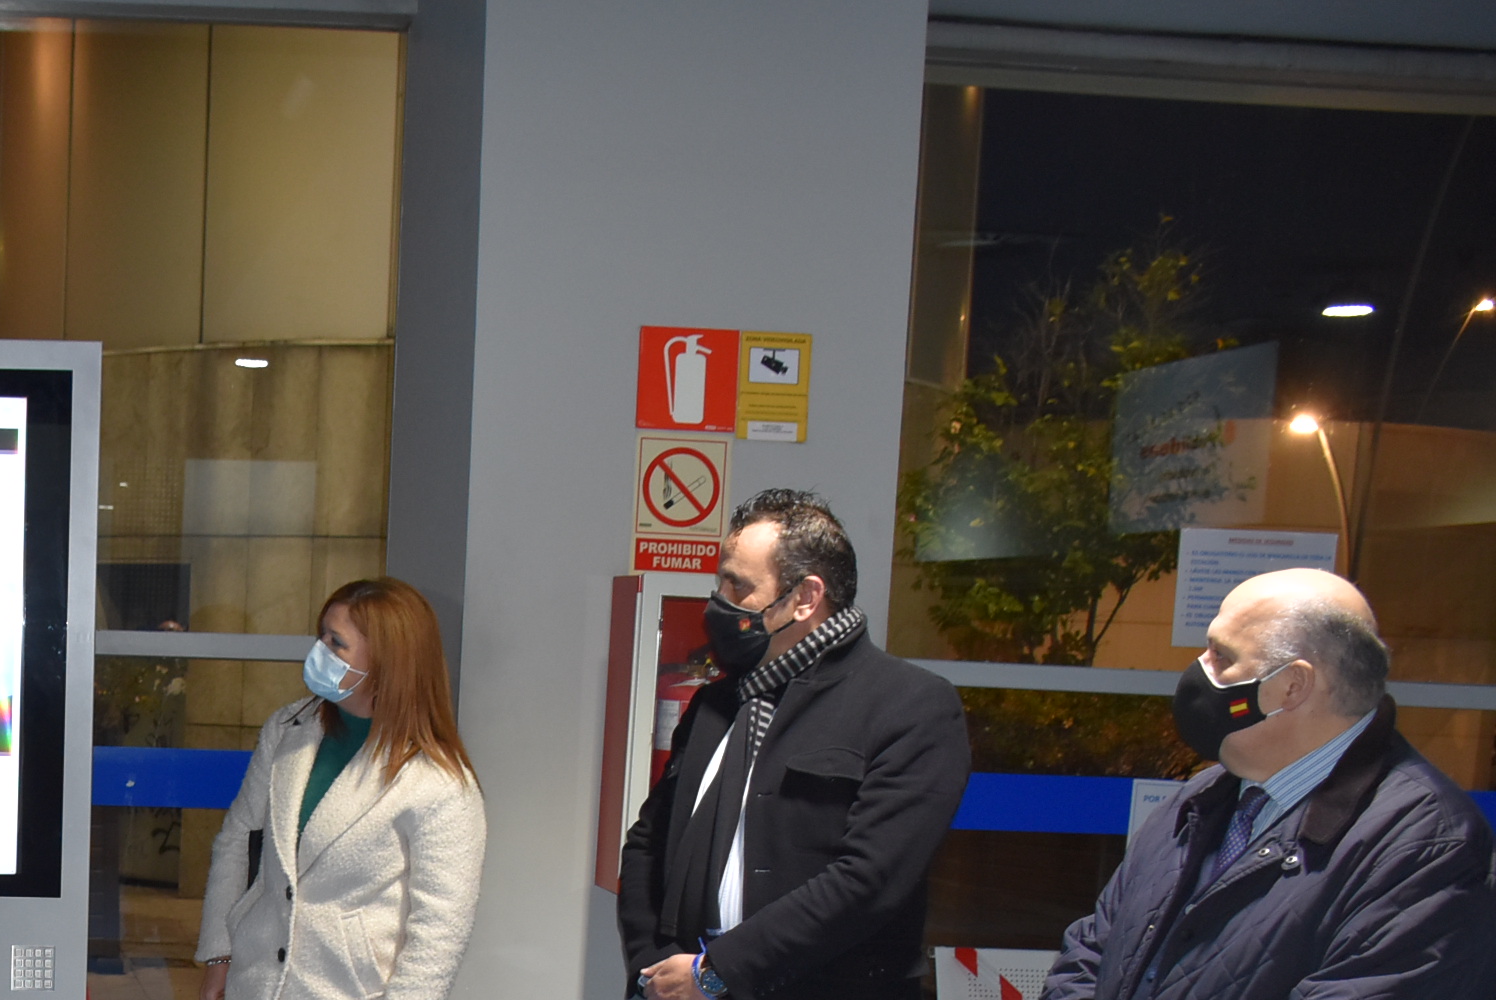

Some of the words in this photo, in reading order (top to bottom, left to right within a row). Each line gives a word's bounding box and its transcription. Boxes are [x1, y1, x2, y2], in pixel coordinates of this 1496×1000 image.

[639, 541, 717, 557] PROHIBIDO
[652, 556, 702, 570] FUMAR
[1143, 795, 1160, 803] POR
